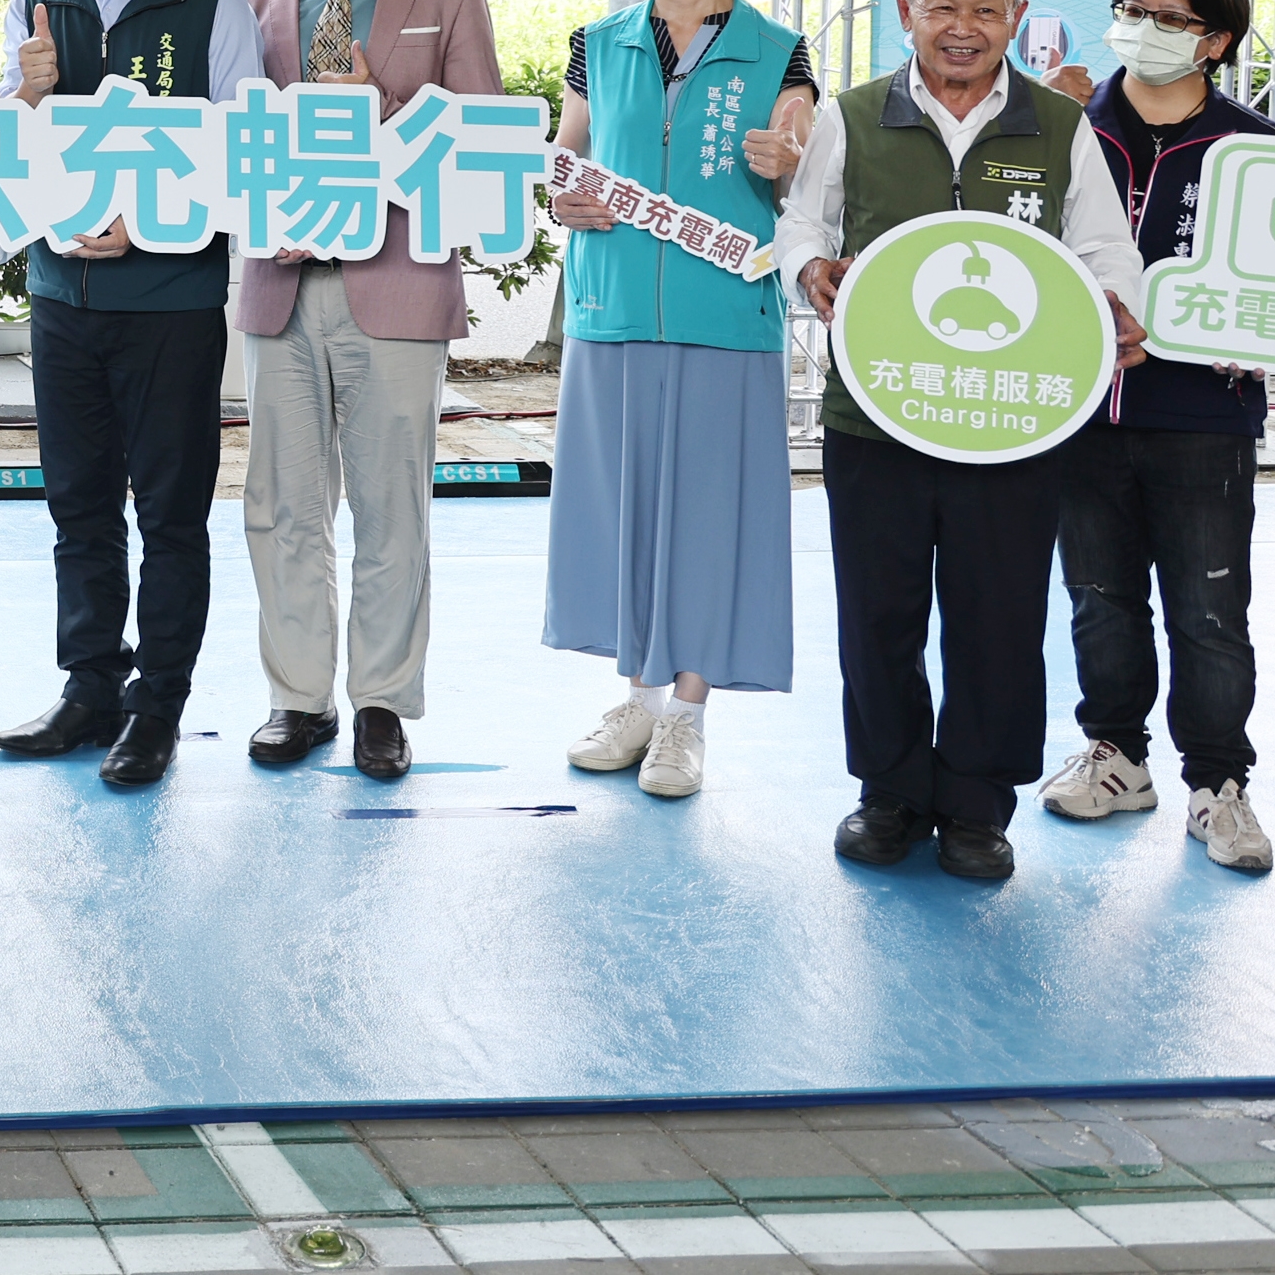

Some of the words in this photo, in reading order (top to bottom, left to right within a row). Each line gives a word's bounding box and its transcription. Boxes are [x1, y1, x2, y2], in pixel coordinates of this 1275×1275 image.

[127, 55, 147, 79] 王
[704, 86, 723, 118] 區長
[716, 75, 745, 175] 南區區公所
[1001, 168, 1042, 181] DPP
[1006, 190, 1044, 225] 林
[901, 399, 1038, 435] Charging
[442, 465, 502, 482] CCS1
